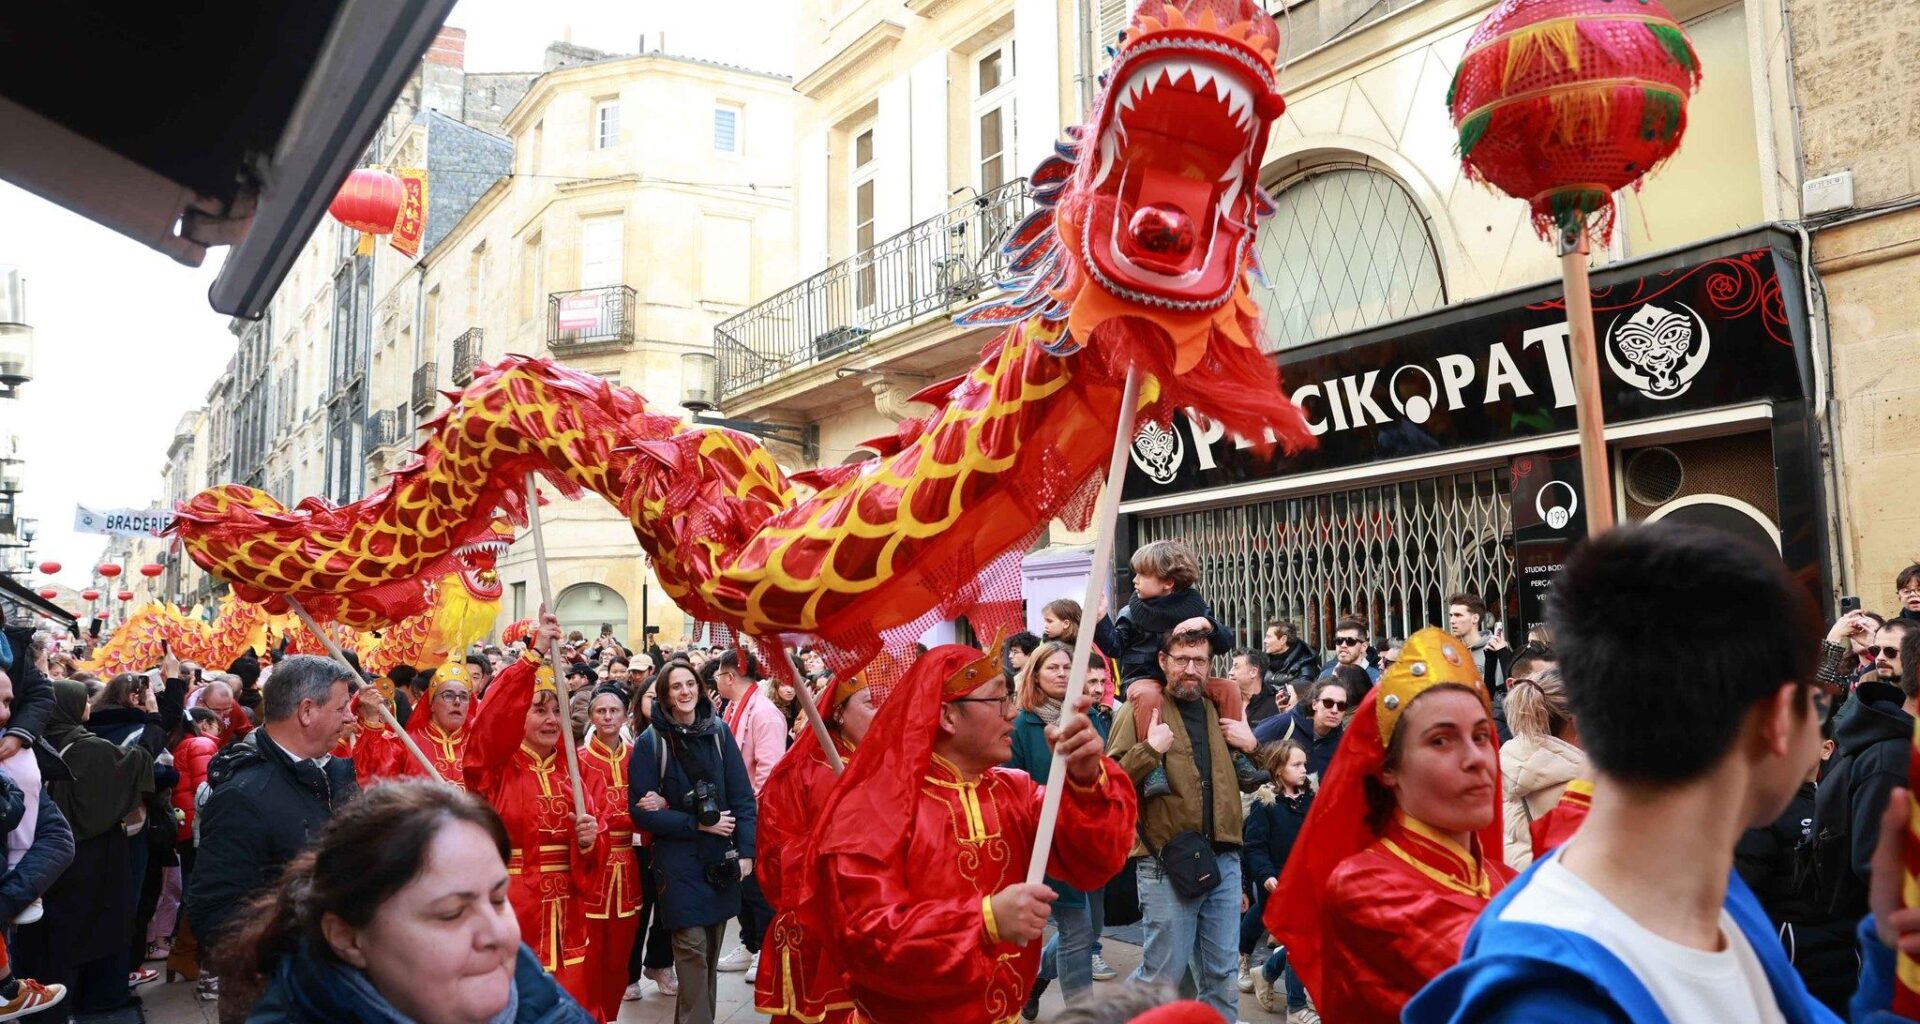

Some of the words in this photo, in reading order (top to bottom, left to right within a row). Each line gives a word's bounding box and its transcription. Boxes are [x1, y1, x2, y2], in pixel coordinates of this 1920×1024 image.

[1185, 322, 1579, 471] PCIKOPAT
[106, 515, 170, 531] BRADERIE
[1524, 565, 1547, 574] STUDIO
